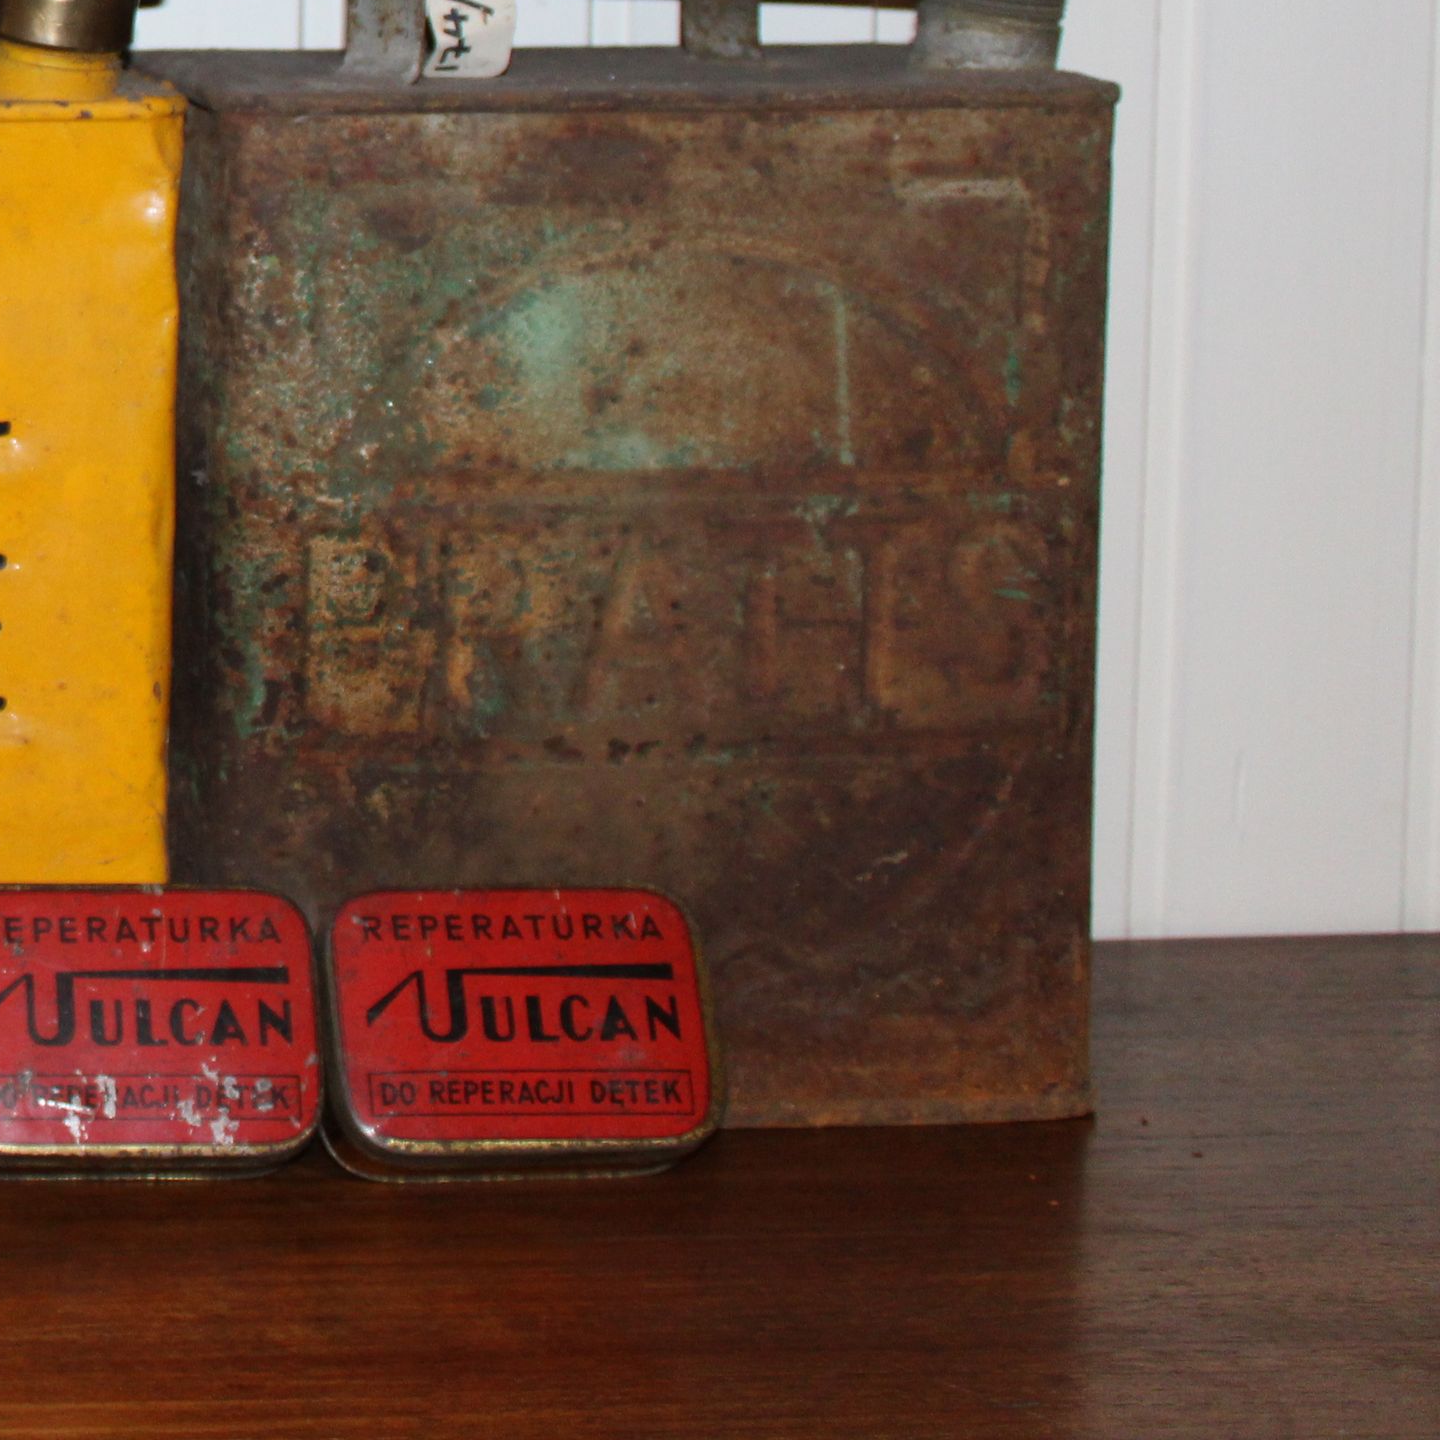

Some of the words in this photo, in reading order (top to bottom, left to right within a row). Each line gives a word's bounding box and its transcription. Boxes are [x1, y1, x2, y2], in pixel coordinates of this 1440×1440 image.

[361, 913, 665, 945] REPERATURKA
[380, 1081, 417, 1107] DO
[429, 1079, 576, 1106] REPERACJI
